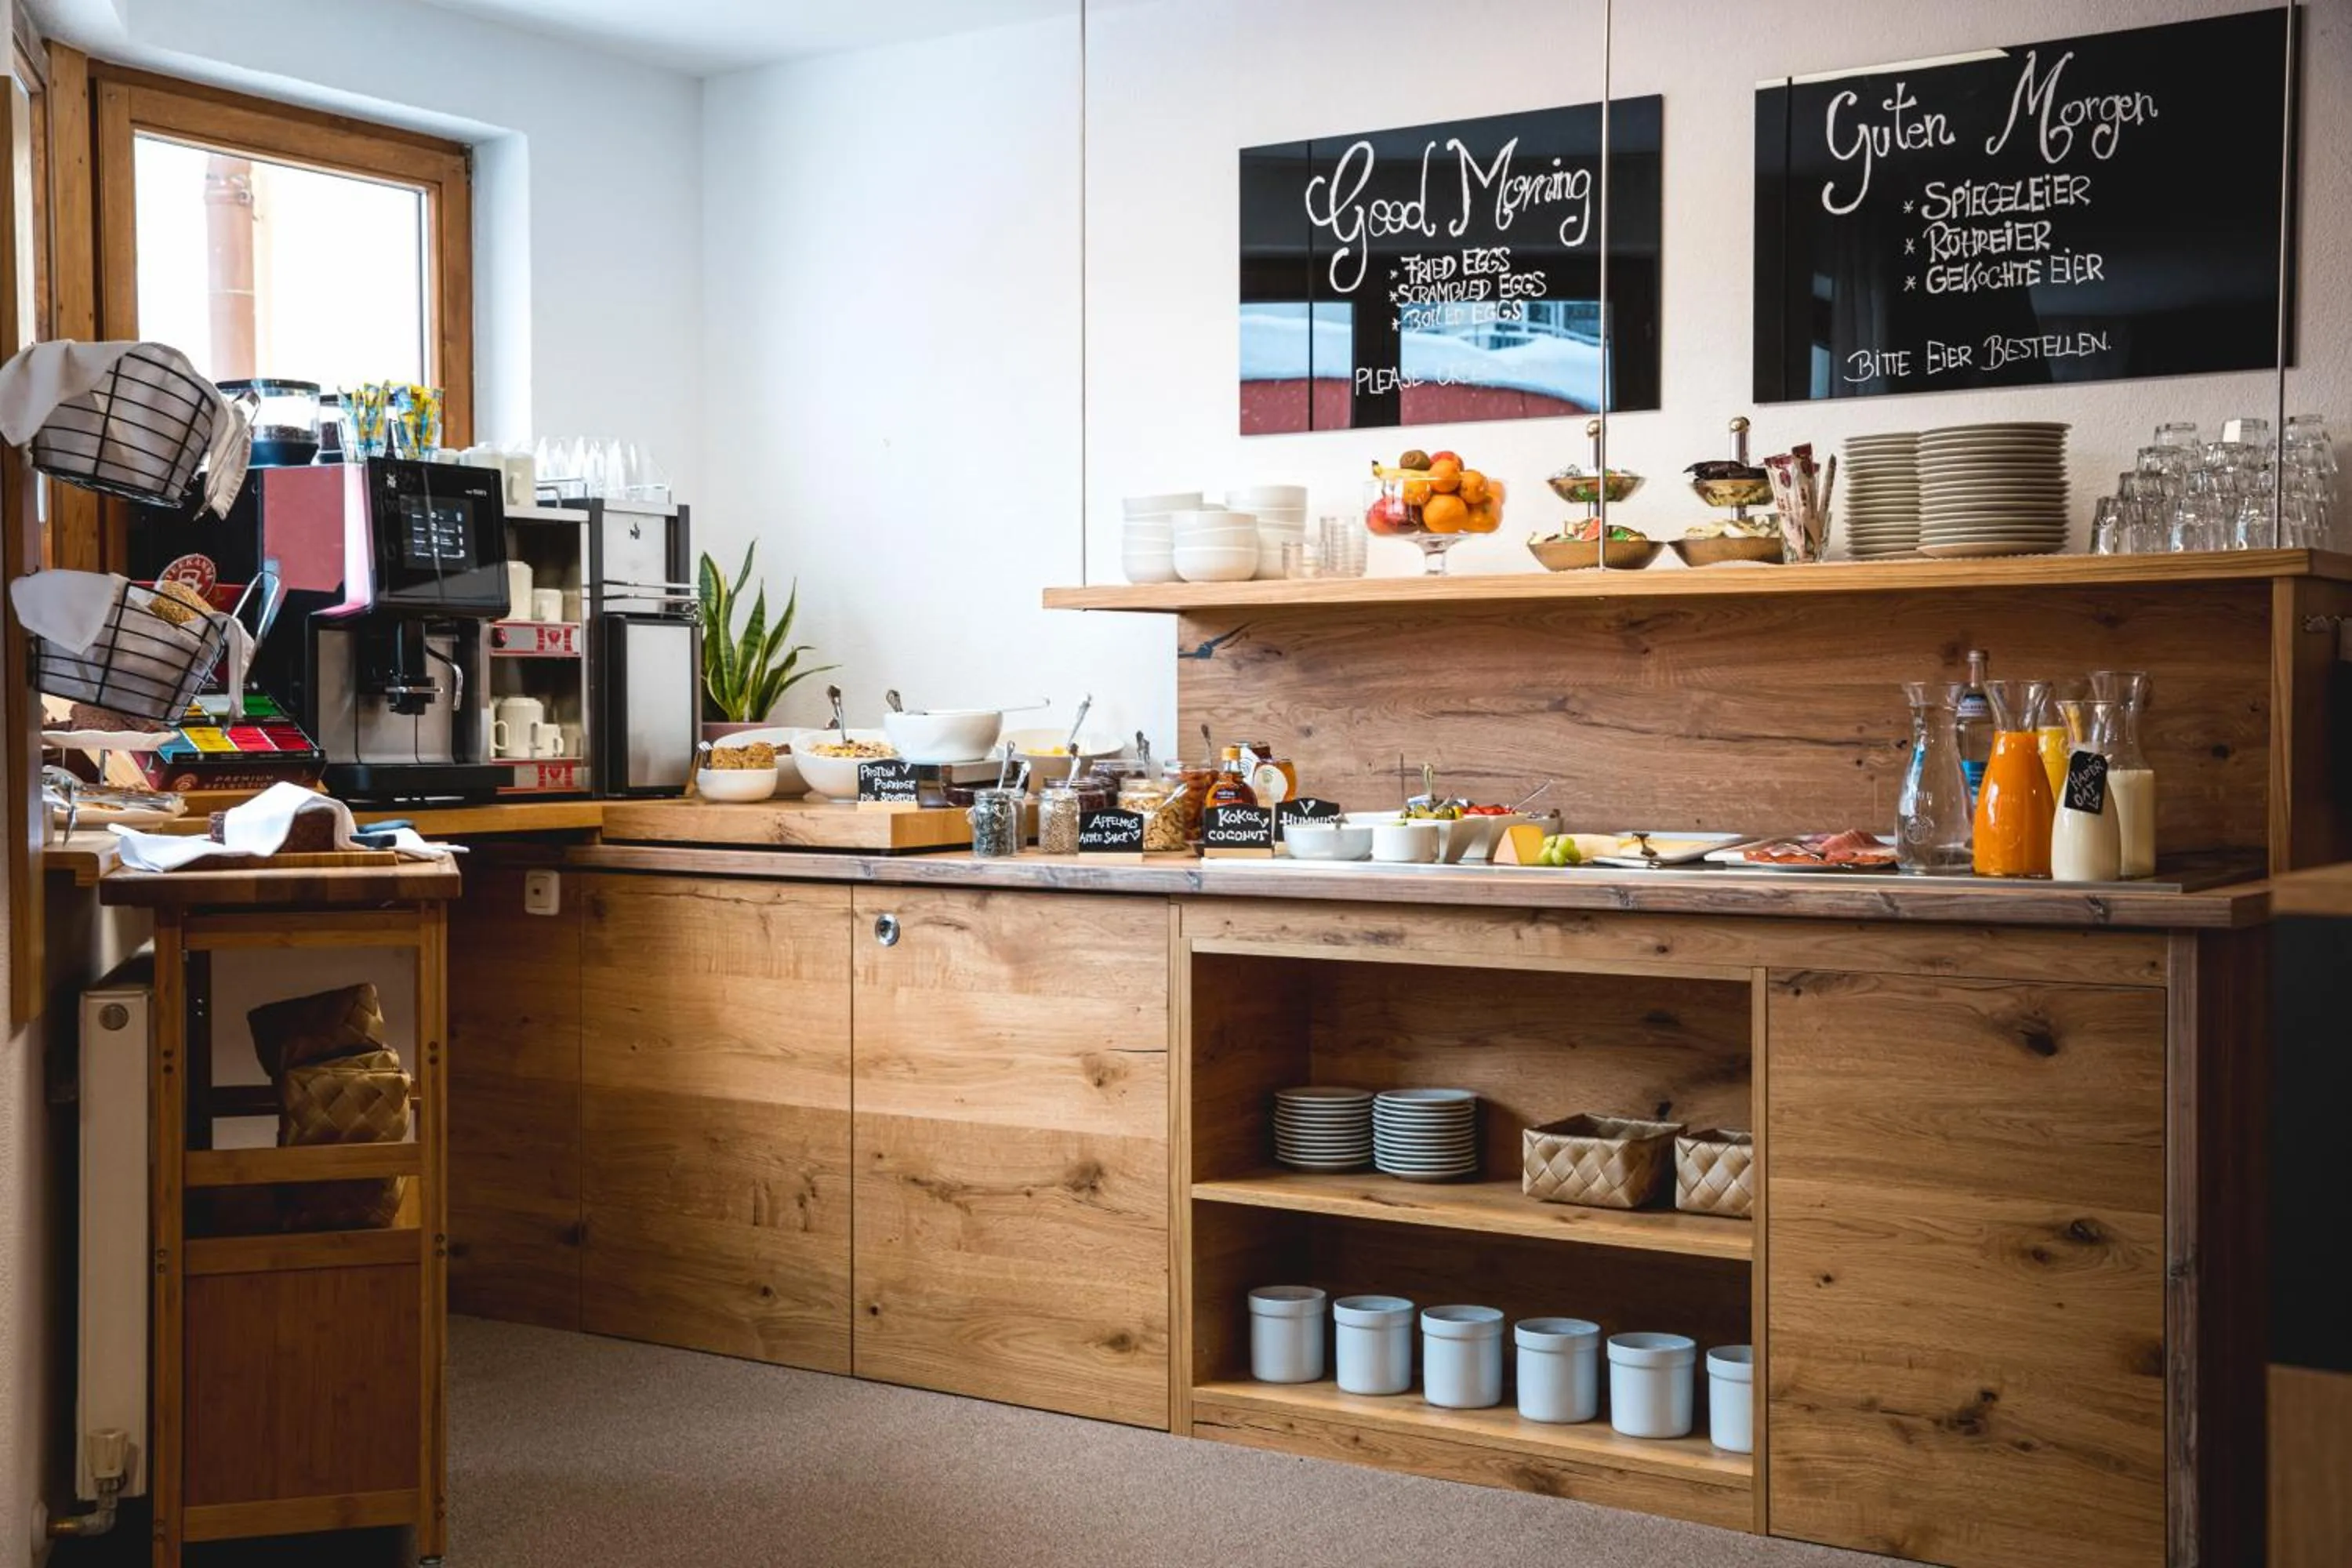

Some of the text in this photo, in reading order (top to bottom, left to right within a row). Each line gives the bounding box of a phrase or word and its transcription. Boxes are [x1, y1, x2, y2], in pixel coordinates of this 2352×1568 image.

[1821, 49, 2158, 216] Guten Morgen
[1305, 140, 1436, 292] Good
[1400, 246, 1512, 285] FRIED EGGS
[1396, 271, 1548, 308] SCRAMBLED EGGS
[1472, 299, 1524, 325] EGGS
[1207, 829, 1269, 842] COCONUT
